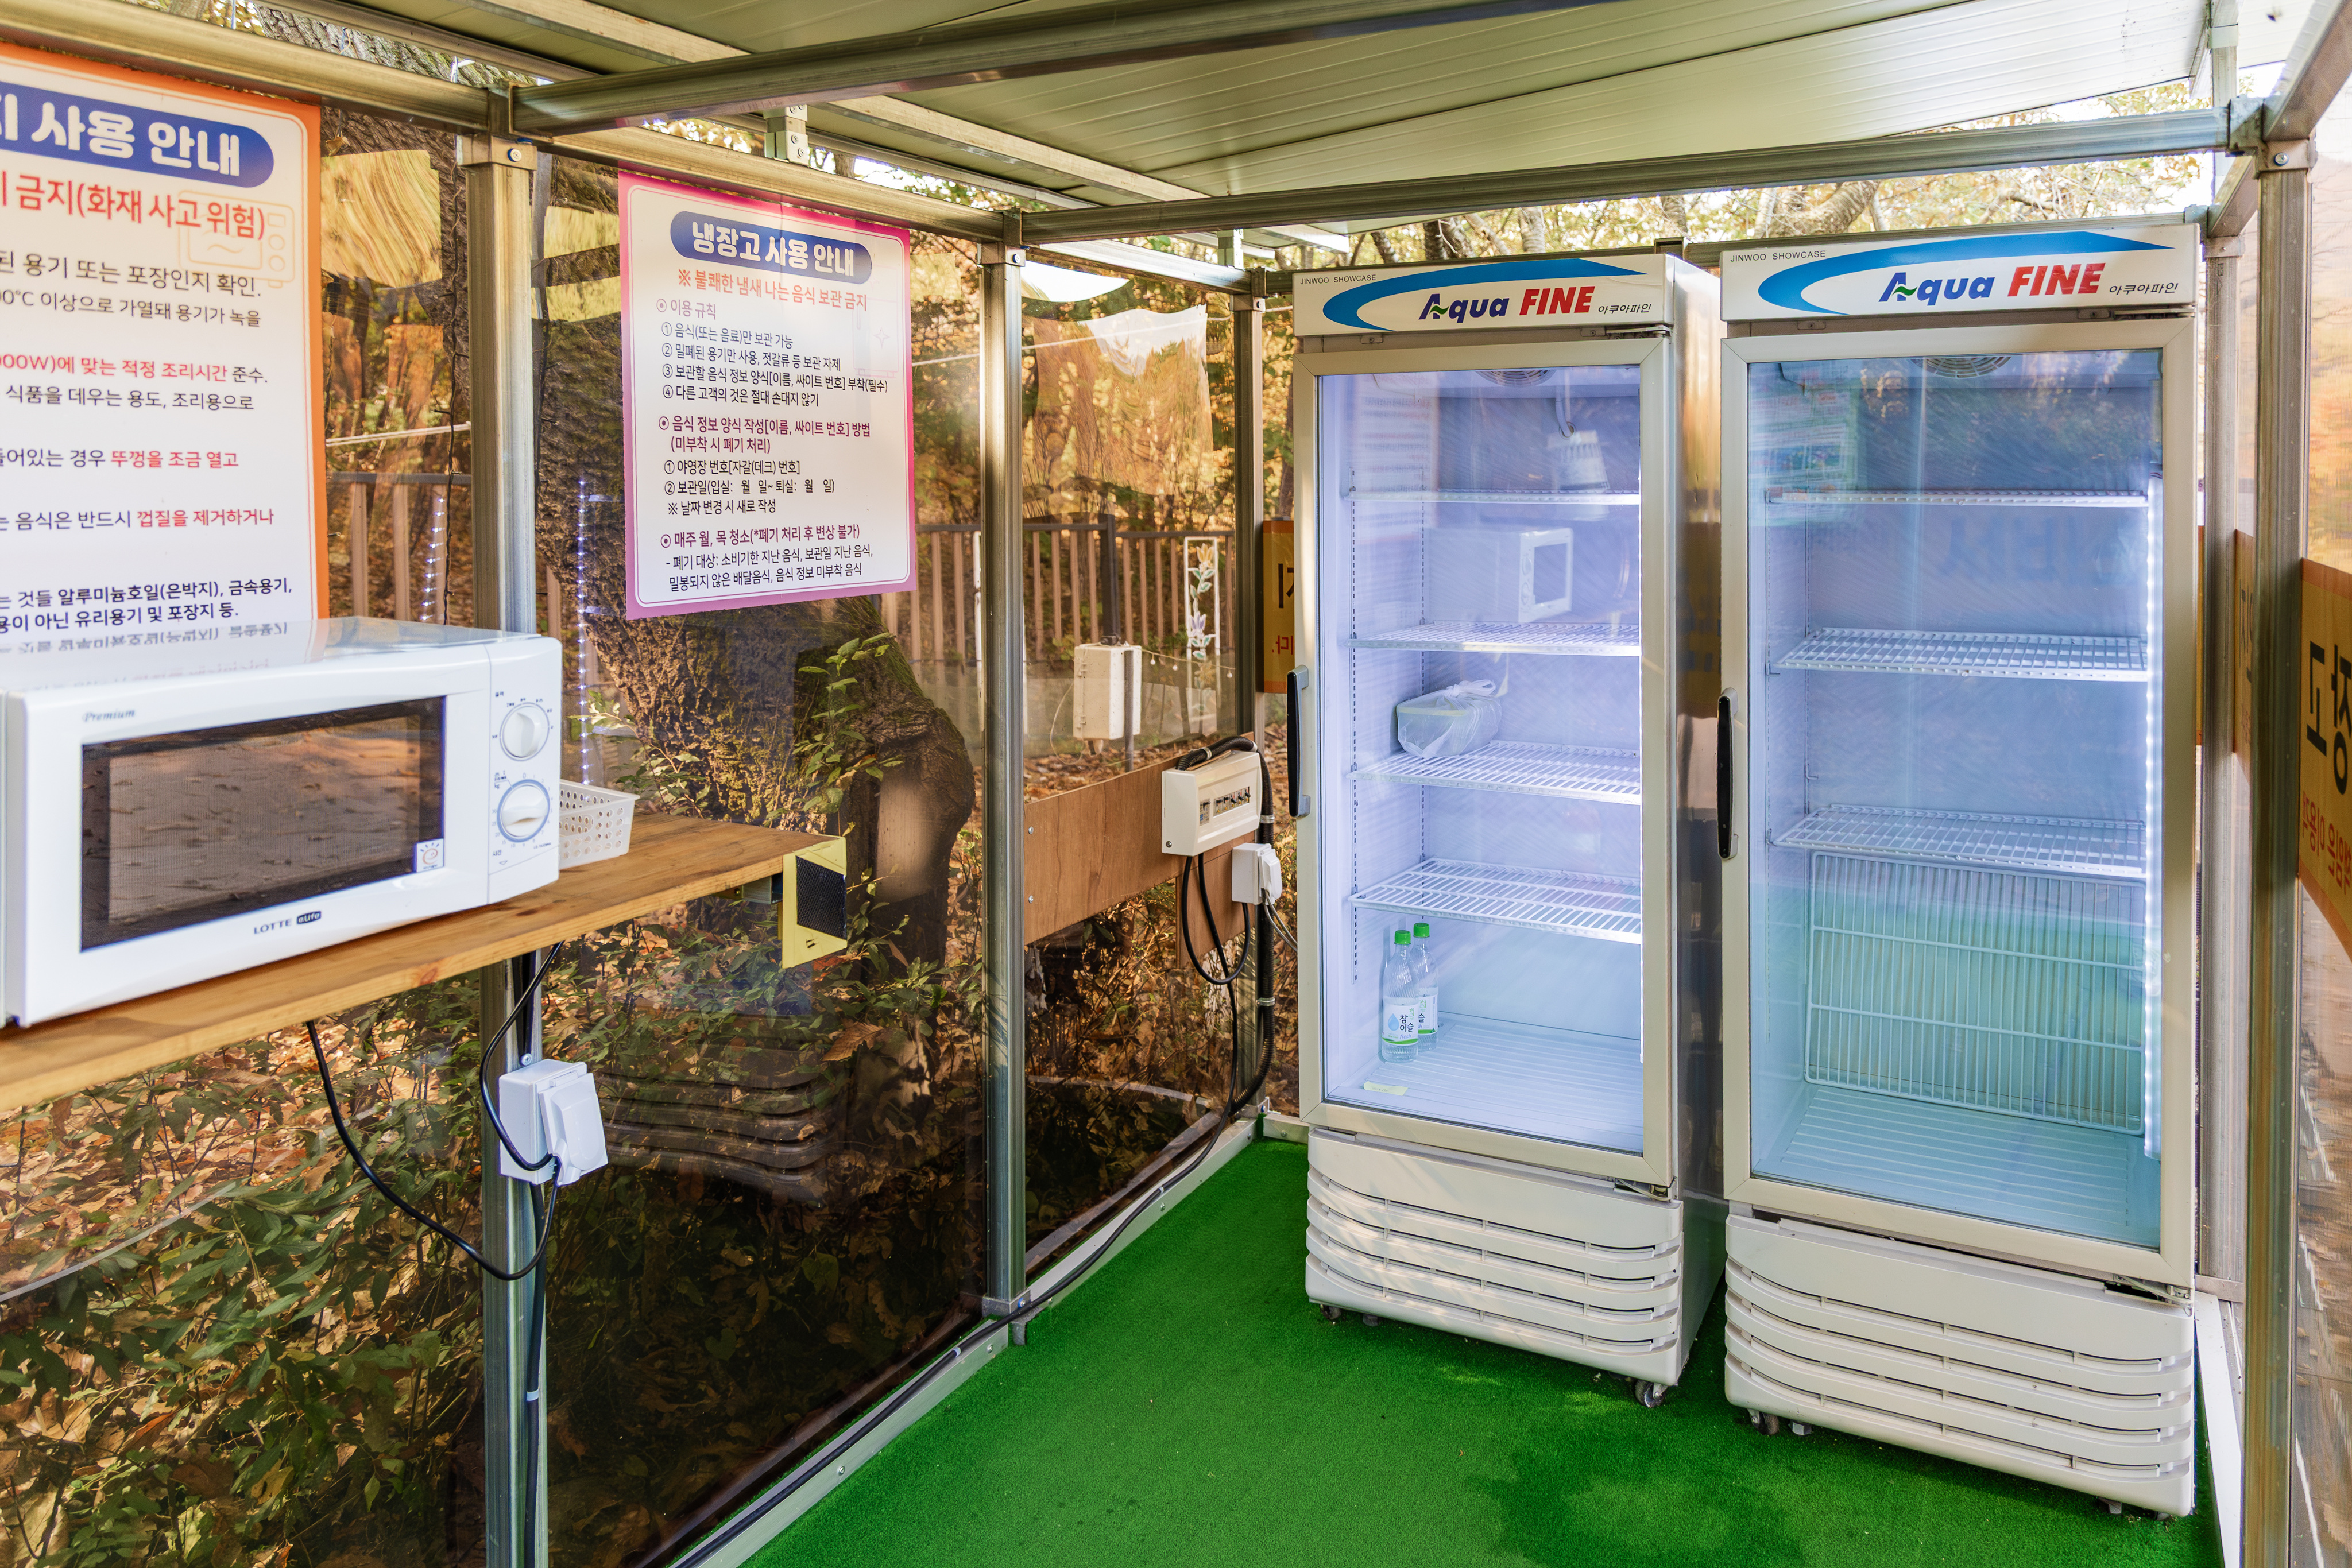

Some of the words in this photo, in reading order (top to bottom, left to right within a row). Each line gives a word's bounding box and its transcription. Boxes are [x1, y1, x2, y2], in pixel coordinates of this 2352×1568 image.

[31, 102, 135, 158] 사용
[148, 122, 240, 176] 안내
[16, 175, 142, 224] 금지(화재
[149, 195, 201, 227] 사고
[207, 202, 265, 240] 위험)
[693, 222, 761, 261] 냉장고
[765, 236, 808, 269] 사용
[814, 245, 854, 277] 안내
[1731, 254, 1766, 262] JINWOO
[1771, 250, 1827, 261] SHOWCASE
[23, 254, 67, 278] 용기
[76, 260, 120, 284] 또는
[127, 266, 210, 293] 포장인지
[217, 274, 261, 297] 확인.
[1301, 273, 1331, 285] JINWOO
[1333, 273, 1377, 284] SHOWCASE
[1879, 272, 1995, 306] Aqua
[2007, 263, 2106, 296] FINE
[695, 270, 733, 293] 불쾌한
[737, 277, 761, 297] 냄새
[765, 281, 789, 301] 나는
[792, 285, 814, 305] 음식
[819, 289, 842, 308] 보관
[845, 292, 866, 311] 금지
[2109, 282, 2178, 295] 아쿠아파인
[41, 292, 114, 313] 이상으로
[120, 300, 171, 319] 가열돼
[176, 305, 225, 324] 용기가
[230, 309, 261, 327] 녹을
[671, 300, 692, 317] 이용
[695, 303, 715, 320] 규칙
[1418, 293, 1509, 323] Aqua
[1519, 286, 1595, 315] FINE
[1598, 304, 1651, 315] 아쿠아파인
[675, 323, 718, 341] 음식(또는
[720, 328, 752, 344] 음료)만
[755, 332, 772, 347] 보관
[775, 334, 793, 349] 가능
[676, 344, 704, 360] 밀폐된
[707, 347, 736, 363] 용기만
[738, 350, 760, 366] 사용,
[792, 355, 801, 369] 등
[803, 357, 821, 370] 보관
[823, 358, 841, 371] 자제
[81, 358, 116, 375] 맞는
[122, 361, 154, 378] 적정
[161, 363, 227, 381] 조리시간
[233, 367, 267, 383] 준수.
[675, 365, 705, 381] 보관할
[707, 367, 726, 382] 음식
[730, 369, 748, 384] 정보
[796, 374, 823, 388] 싸이트
[825, 376, 845, 390] 번호]
[847, 378, 887, 393] 부착(필수)
[6, 385, 62, 404] 식품을
[69, 388, 122, 406] 데우는
[127, 390, 166, 409] 용도,
[172, 393, 254, 411] 조리용으로
[676, 385, 696, 400] 다른
[698, 387, 727, 402] 고객의
[730, 389, 748, 403] 것은
[751, 390, 769, 404] 절대
[772, 391, 800, 406] 손대지
[800, 393, 818, 407] 않기
[672, 416, 694, 432] 음식
[697, 416, 718, 433] 정보
[721, 417, 741, 433] 양식
[795, 420, 824, 436] 싸이트
[827, 421, 849, 437] 번호]
[852, 423, 870, 437] 방법
[671, 436, 707, 452] (미부착
[710, 437, 720, 452] 시
[724, 438, 743, 453] 폐기
[746, 438, 770, 454] 처리)
[0, 448, 64, 467] 어있는
[71, 450, 105, 467] 경우
[111, 451, 163, 468] 뚜껑을
[168, 452, 201, 468] 조금
[207, 452, 238, 468] 열고
[678, 460, 707, 475] 야영장
[779, 460, 800, 475] 번호]
[741, 479, 751, 494] 월
[804, 479, 813, 493] 월
[823, 479, 834, 493] 일)
[16, 512, 72, 531] 음식은
[78, 510, 130, 529] 반드시
[138, 510, 188, 527] 껍질을
[193, 509, 274, 526] 제거하거나
[680, 501, 701, 516] 날짜
[703, 500, 722, 514] 변경
[725, 500, 734, 514] 시
[736, 499, 756, 514] 새로
[758, 499, 776, 513] 작성
[675, 532, 696, 548] 매주
[699, 531, 713, 547] 월,
[716, 531, 726, 545] 목
[782, 526, 800, 542] 처리
[804, 525, 813, 541] 후
[816, 525, 835, 540] 변상
[837, 524, 860, 539] 불가)
[673, 555, 693, 570] 폐기
[721, 551, 759, 566] 소비기한
[761, 549, 780, 564] 지난
[782, 548, 802, 563] 음식,
[805, 546, 831, 560] 보관일
[834, 545, 851, 559] 지난
[853, 544, 873, 557] 음식,
[670, 574, 709, 592] 밀봉되지
[712, 572, 731, 588] 않은
[776, 567, 793, 582] 음식
[796, 567, 814, 580] 정보
[817, 564, 843, 578] 미부착
[845, 563, 861, 576] 음식
[18, 590, 52, 608] 것들
[58, 582, 223, 603] 알루미늄호일(은박지),
[229, 578, 292, 595] 금속용기,
[35, 612, 69, 630] 아닌
[75, 607, 141, 628] 유리용기
[148, 606, 162, 622] 및
[168, 603, 214, 622] 포장지
[219, 602, 238, 618] 등.
[254, 919, 291, 934] LOTTE
